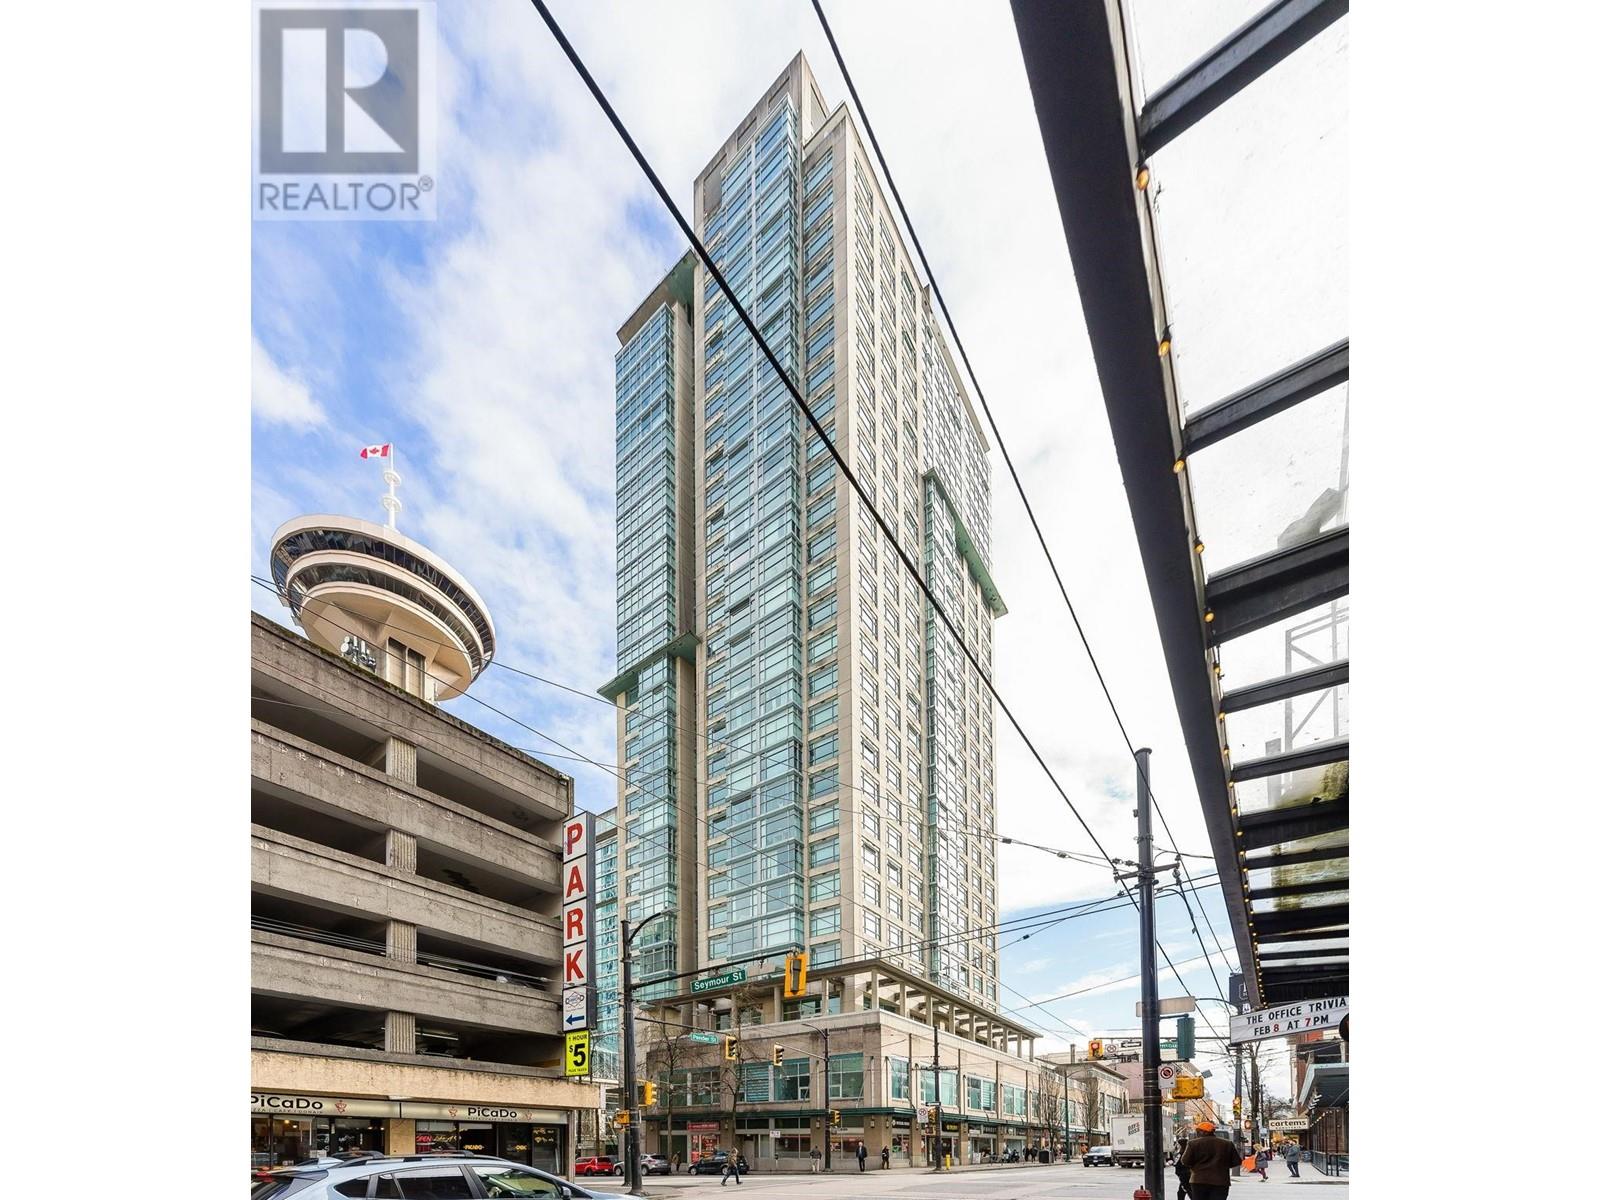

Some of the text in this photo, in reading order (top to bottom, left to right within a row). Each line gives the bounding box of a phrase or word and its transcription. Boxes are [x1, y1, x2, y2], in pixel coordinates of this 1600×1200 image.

[566, 822, 585, 983] PARK
[694, 972, 742, 990] Seymour St
[1246, 997, 1347, 1025] THE OFFICE TRIVIA
[1254, 1025, 1271, 1036] FEB
[1273, 1023, 1280, 1033] 8
[1287, 1020, 1300, 1031] AT
[572, 1033, 588, 1041] HOUR
[467, 1107, 518, 1119] PiCaDo
